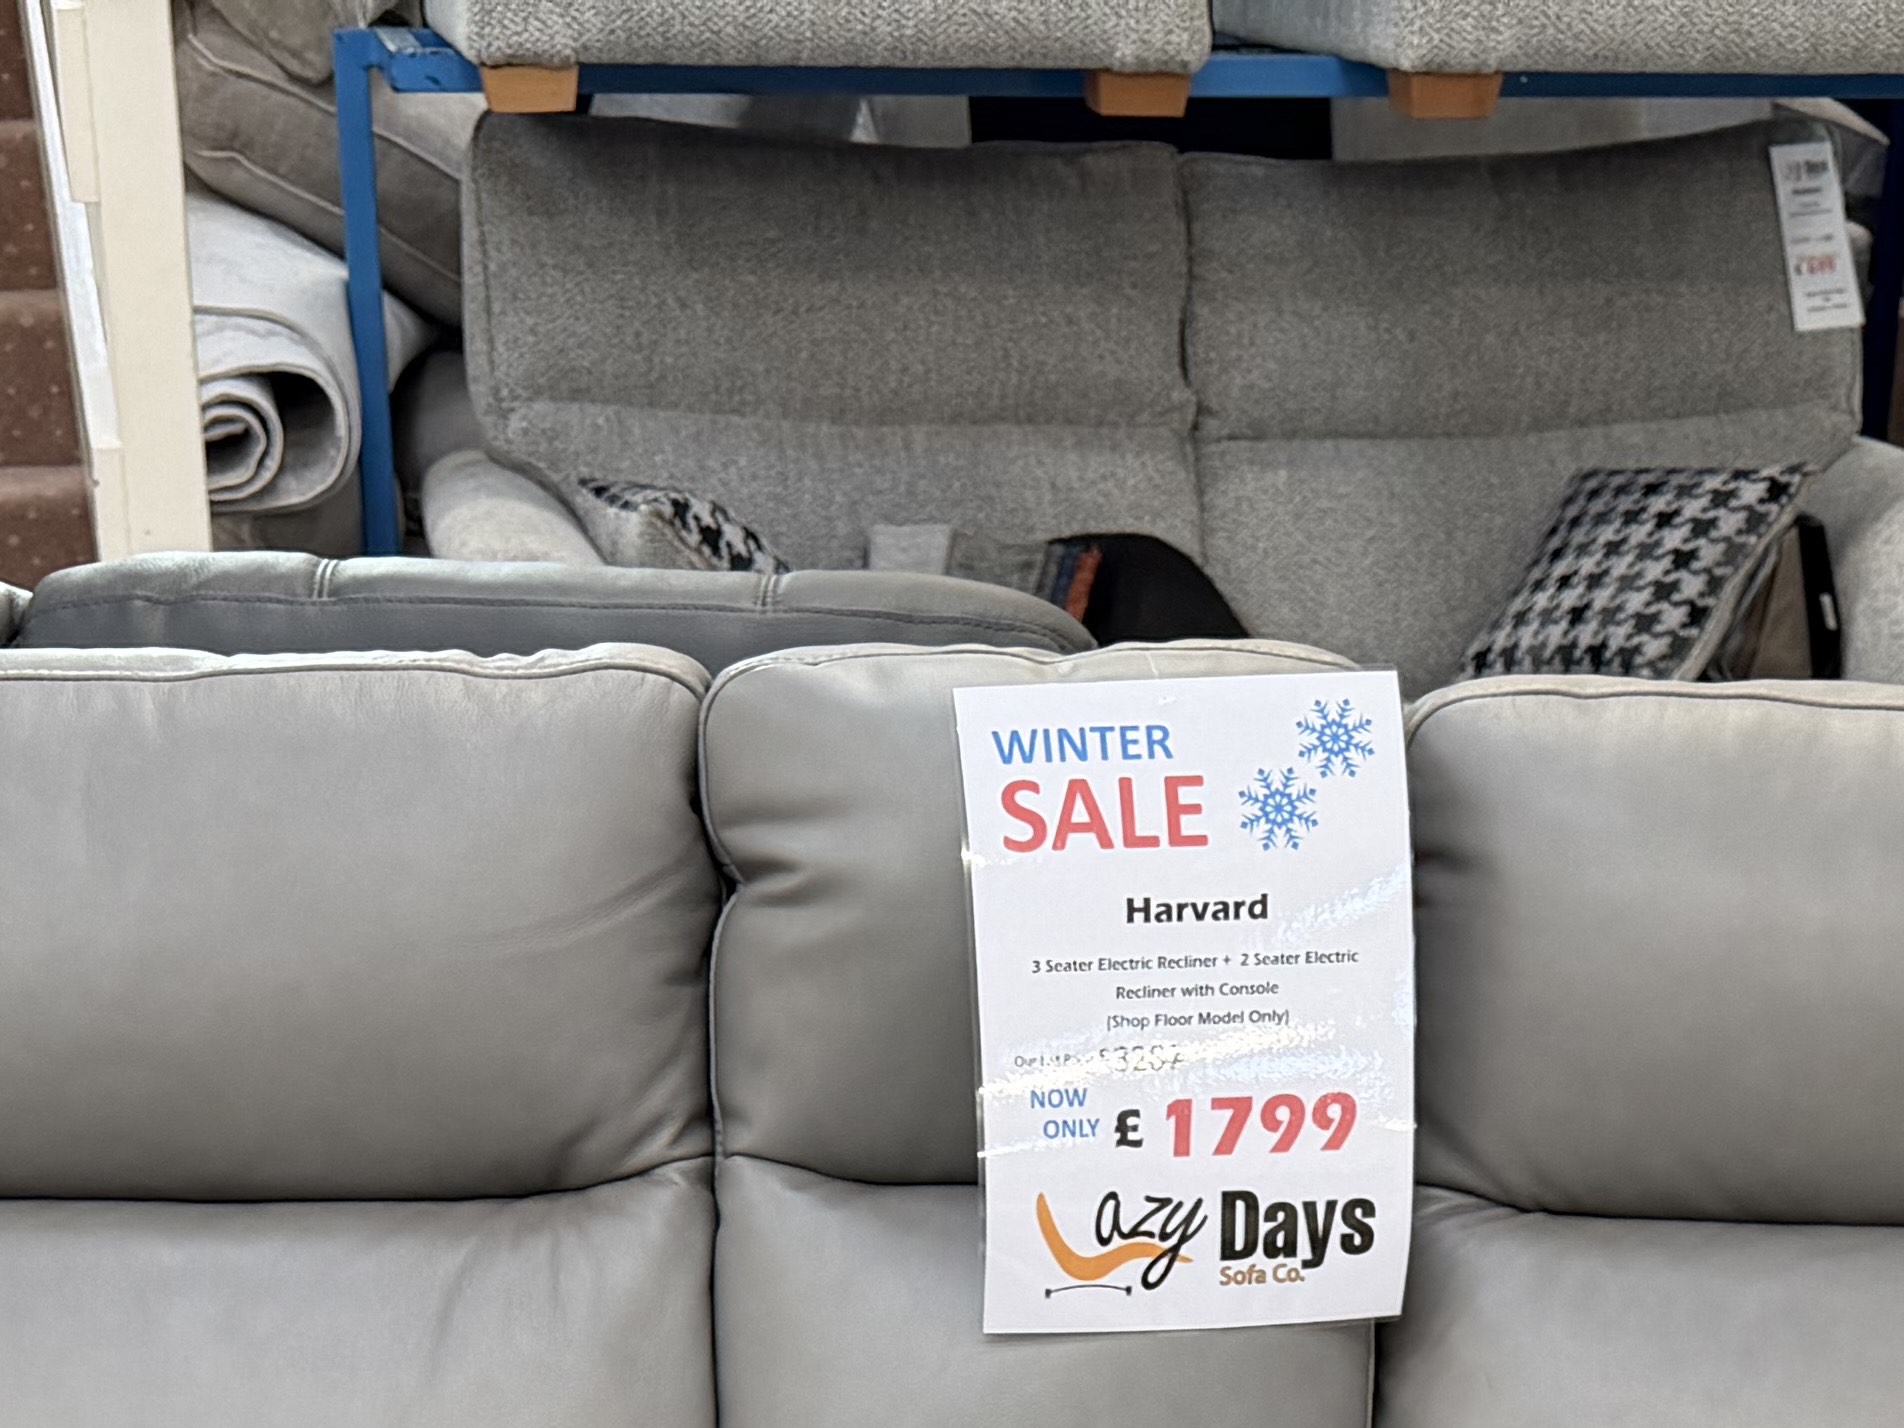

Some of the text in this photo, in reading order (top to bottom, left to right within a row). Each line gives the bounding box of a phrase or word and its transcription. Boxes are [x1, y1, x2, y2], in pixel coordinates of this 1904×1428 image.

[991, 724, 1174, 765] WINTER
[1000, 774, 1209, 853] SALE
[1125, 892, 1269, 924] Harvard
[1031, 960, 1042, 973] 3
[1045, 958, 1094, 973] Seater
[1097, 955, 1154, 971] Electric
[1157, 953, 1218, 969] Recliner
[1240, 953, 1249, 967] 2
[1253, 951, 1301, 966] Seater
[1304, 948, 1360, 964] Electric
[1115, 980, 1280, 1000] Recliner with Console
[1154, 1011, 1194, 1027] Floor
[1198, 1009, 1245, 1025] Model
[1029, 1087, 1088, 1109] NOW
[1042, 1118, 1100, 1139] ONLY
[1114, 1091, 1358, 1158] £ 1799
[1219, 1189, 1377, 1270] Days
[1219, 1262, 1306, 1287] Sofa Co.
